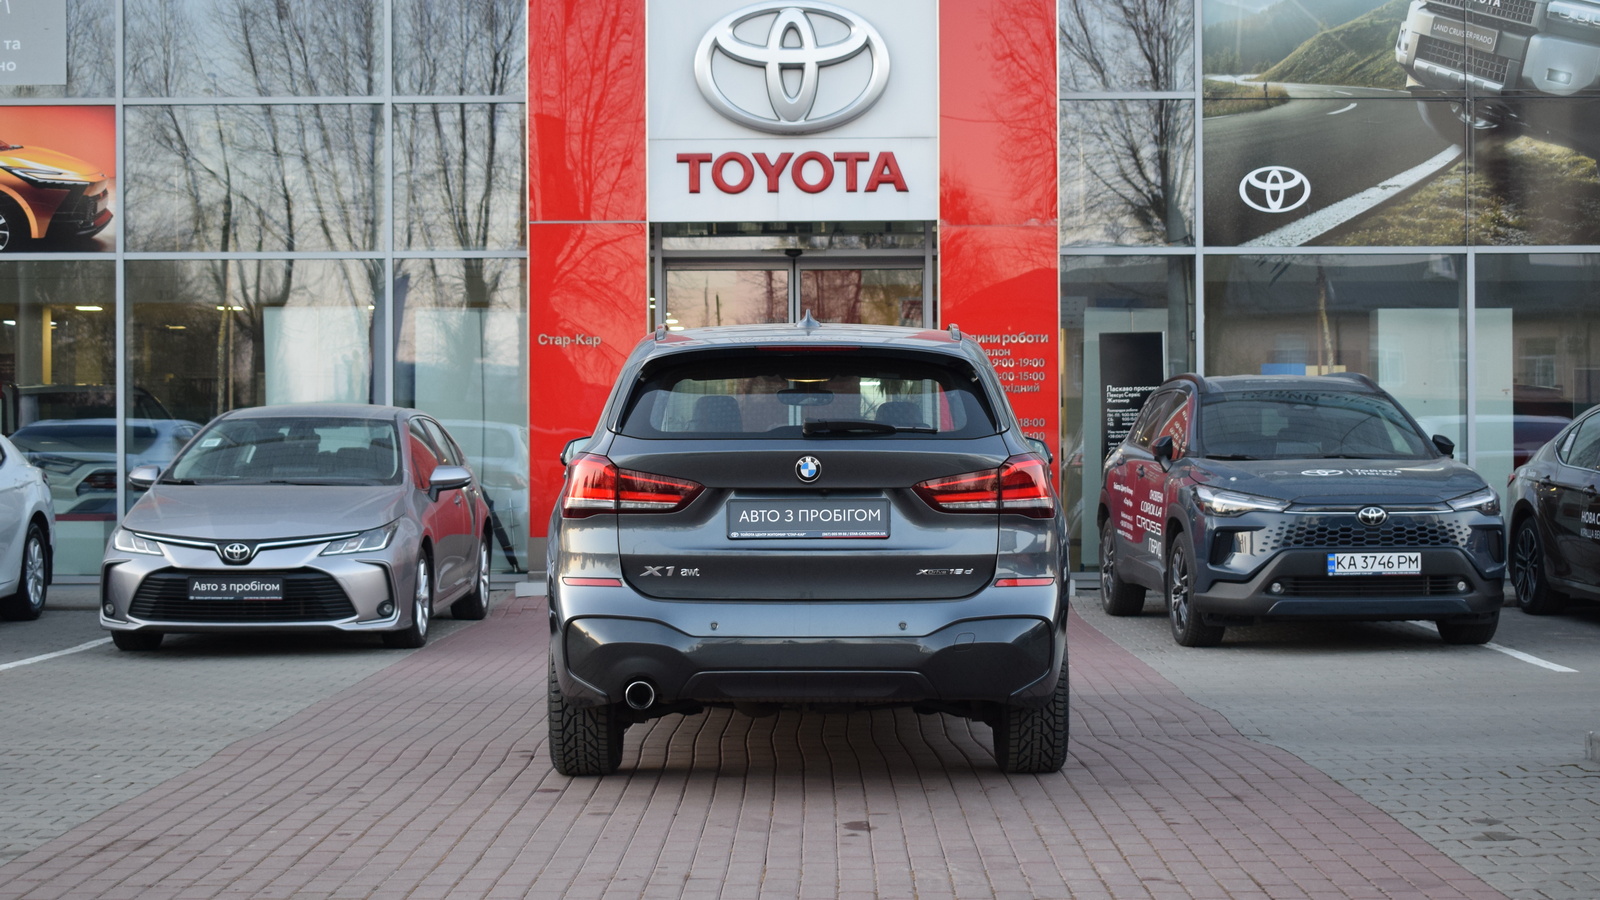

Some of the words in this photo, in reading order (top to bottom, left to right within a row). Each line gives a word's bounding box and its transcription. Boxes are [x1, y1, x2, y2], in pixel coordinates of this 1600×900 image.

[1433, 23, 1448, 33] LAND
[1473, 33, 1493, 45] PRADO
[3, 39, 21, 50] та
[676, 151, 910, 194] TOYOTA
[537, 333, 602, 348] Стар-Кар
[1002, 332, 1049, 346] роботи
[985, 348, 1011, 356] алон
[997, 372, 1045, 381] :00-15:00
[1002, 382, 1040, 393] хідний
[739, 510, 780, 523] АВТО
[784, 510, 794, 522] З
[798, 509, 881, 522] ПРОБІГОМ
[1141, 501, 1163, 518] COROLLA
[1581, 511, 1595, 525] НОВА
[1136, 515, 1162, 536] CROSS
[1336, 555, 1357, 570] KA
[1361, 555, 1394, 569] 3746
[1397, 555, 1419, 569] PM
[640, 565, 675, 577] X1
[193, 581, 218, 591] Авто
[220, 583, 227, 591] з
[229, 580, 280, 593] пробігом
